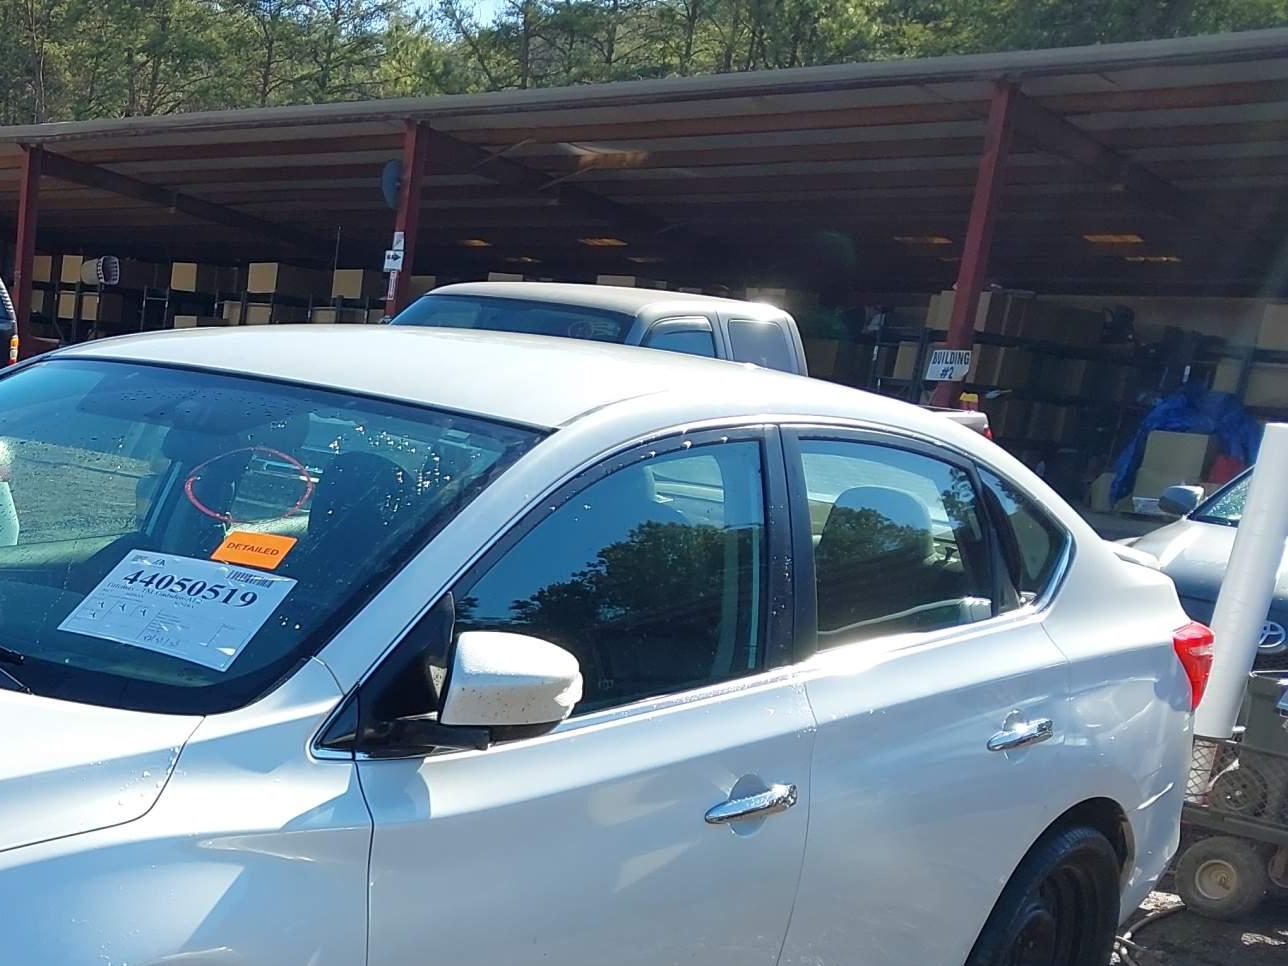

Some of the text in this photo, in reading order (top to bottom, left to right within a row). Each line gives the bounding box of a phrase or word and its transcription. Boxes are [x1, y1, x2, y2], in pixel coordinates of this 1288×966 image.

[932, 351, 970, 365] BUILDING
[940, 366, 954, 379] #2
[226, 542, 280, 556] DETAILED
[122, 569, 260, 609] 44050519
